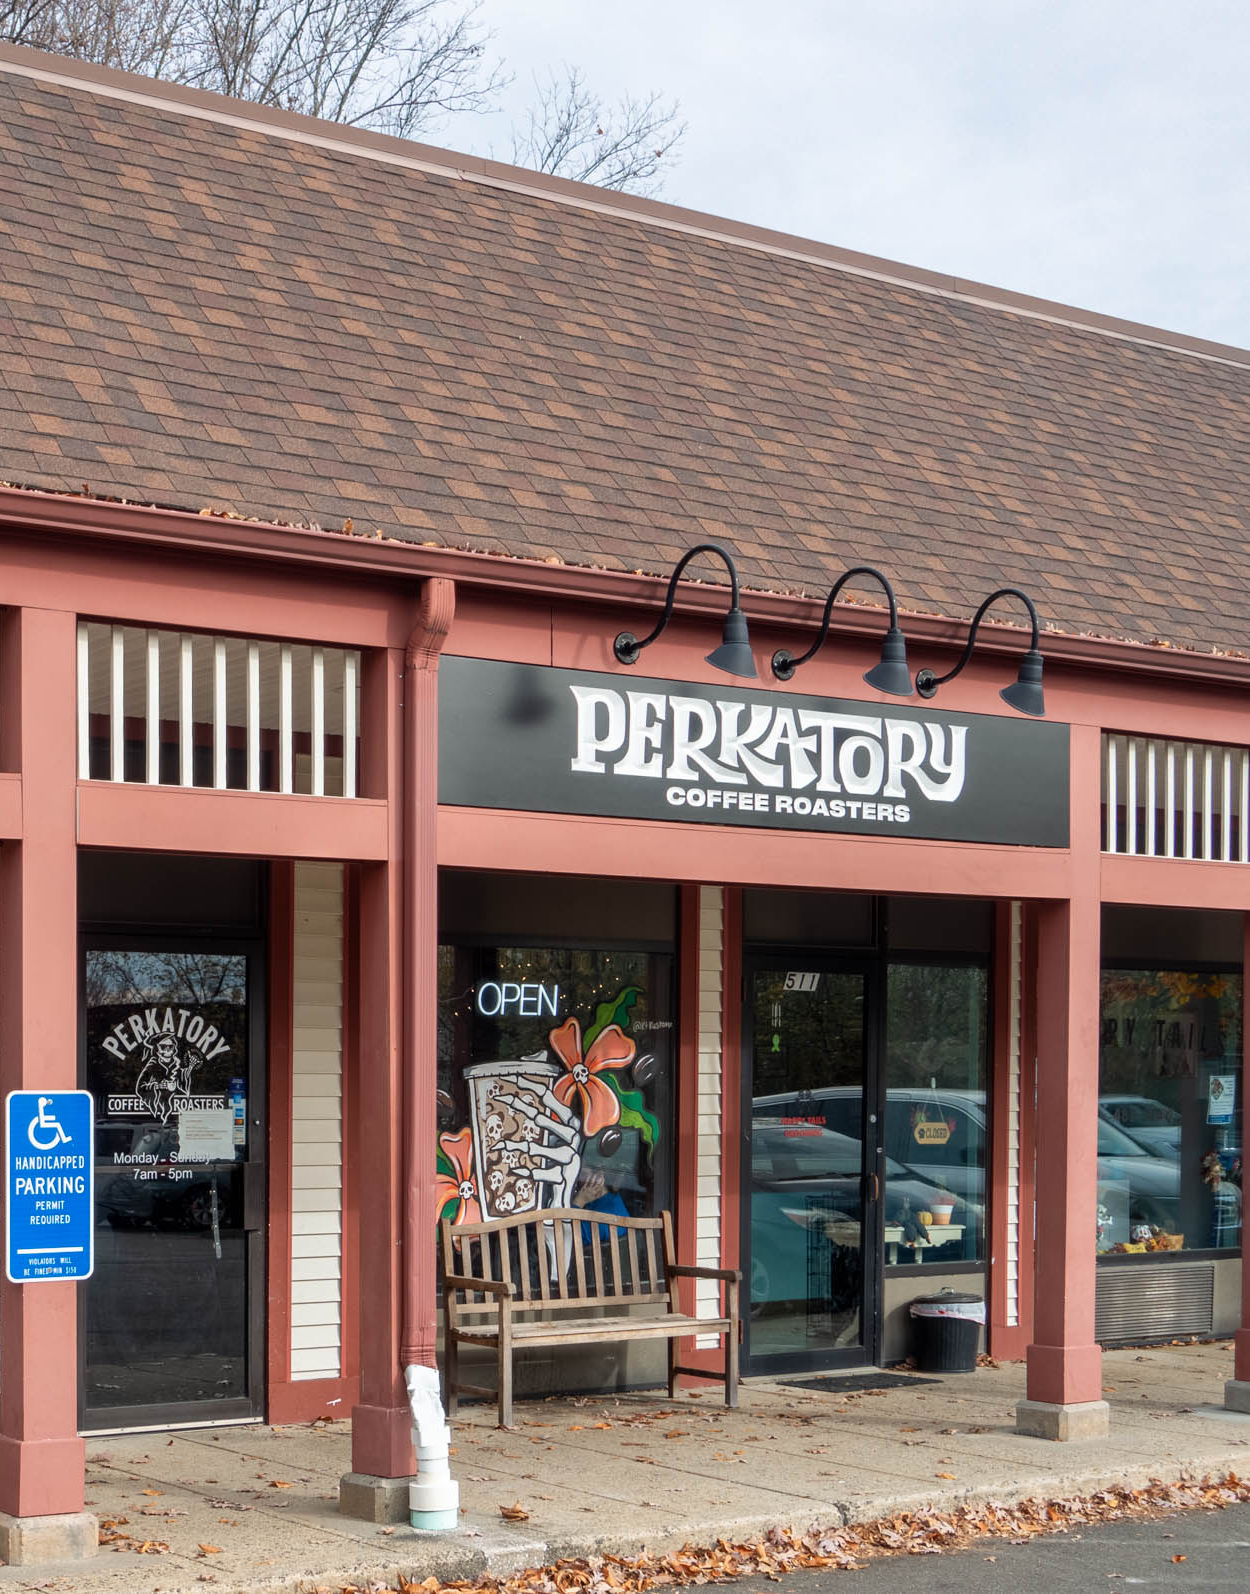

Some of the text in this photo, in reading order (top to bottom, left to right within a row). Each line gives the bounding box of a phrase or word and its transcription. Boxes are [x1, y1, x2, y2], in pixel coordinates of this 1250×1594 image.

[569, 685, 969, 803] PERKATORY
[666, 786, 911, 823] COFFEE ROASTERS
[786, 973, 816, 989] 511
[478, 982, 559, 1017] OPEN
[101, 1007, 231, 1061] PERKATORY
[108, 1098, 225, 1112] COFFEE ROASTERS
[15, 1155, 85, 1170] HANDICAPPED
[113, 1152, 159, 1165] Monday
[169, 1152, 211, 1166] Sunday
[133, 1169, 158, 1180] 7am
[168, 1169, 193, 1181] 5pm
[15, 1176, 85, 1196] PARKING
[35, 1200, 65, 1211] PERMIT
[30, 1214, 71, 1225] REQUIRED
[29, 1257, 56, 1265] VIOLATORS
[23, 1268, 30, 1276] BE
